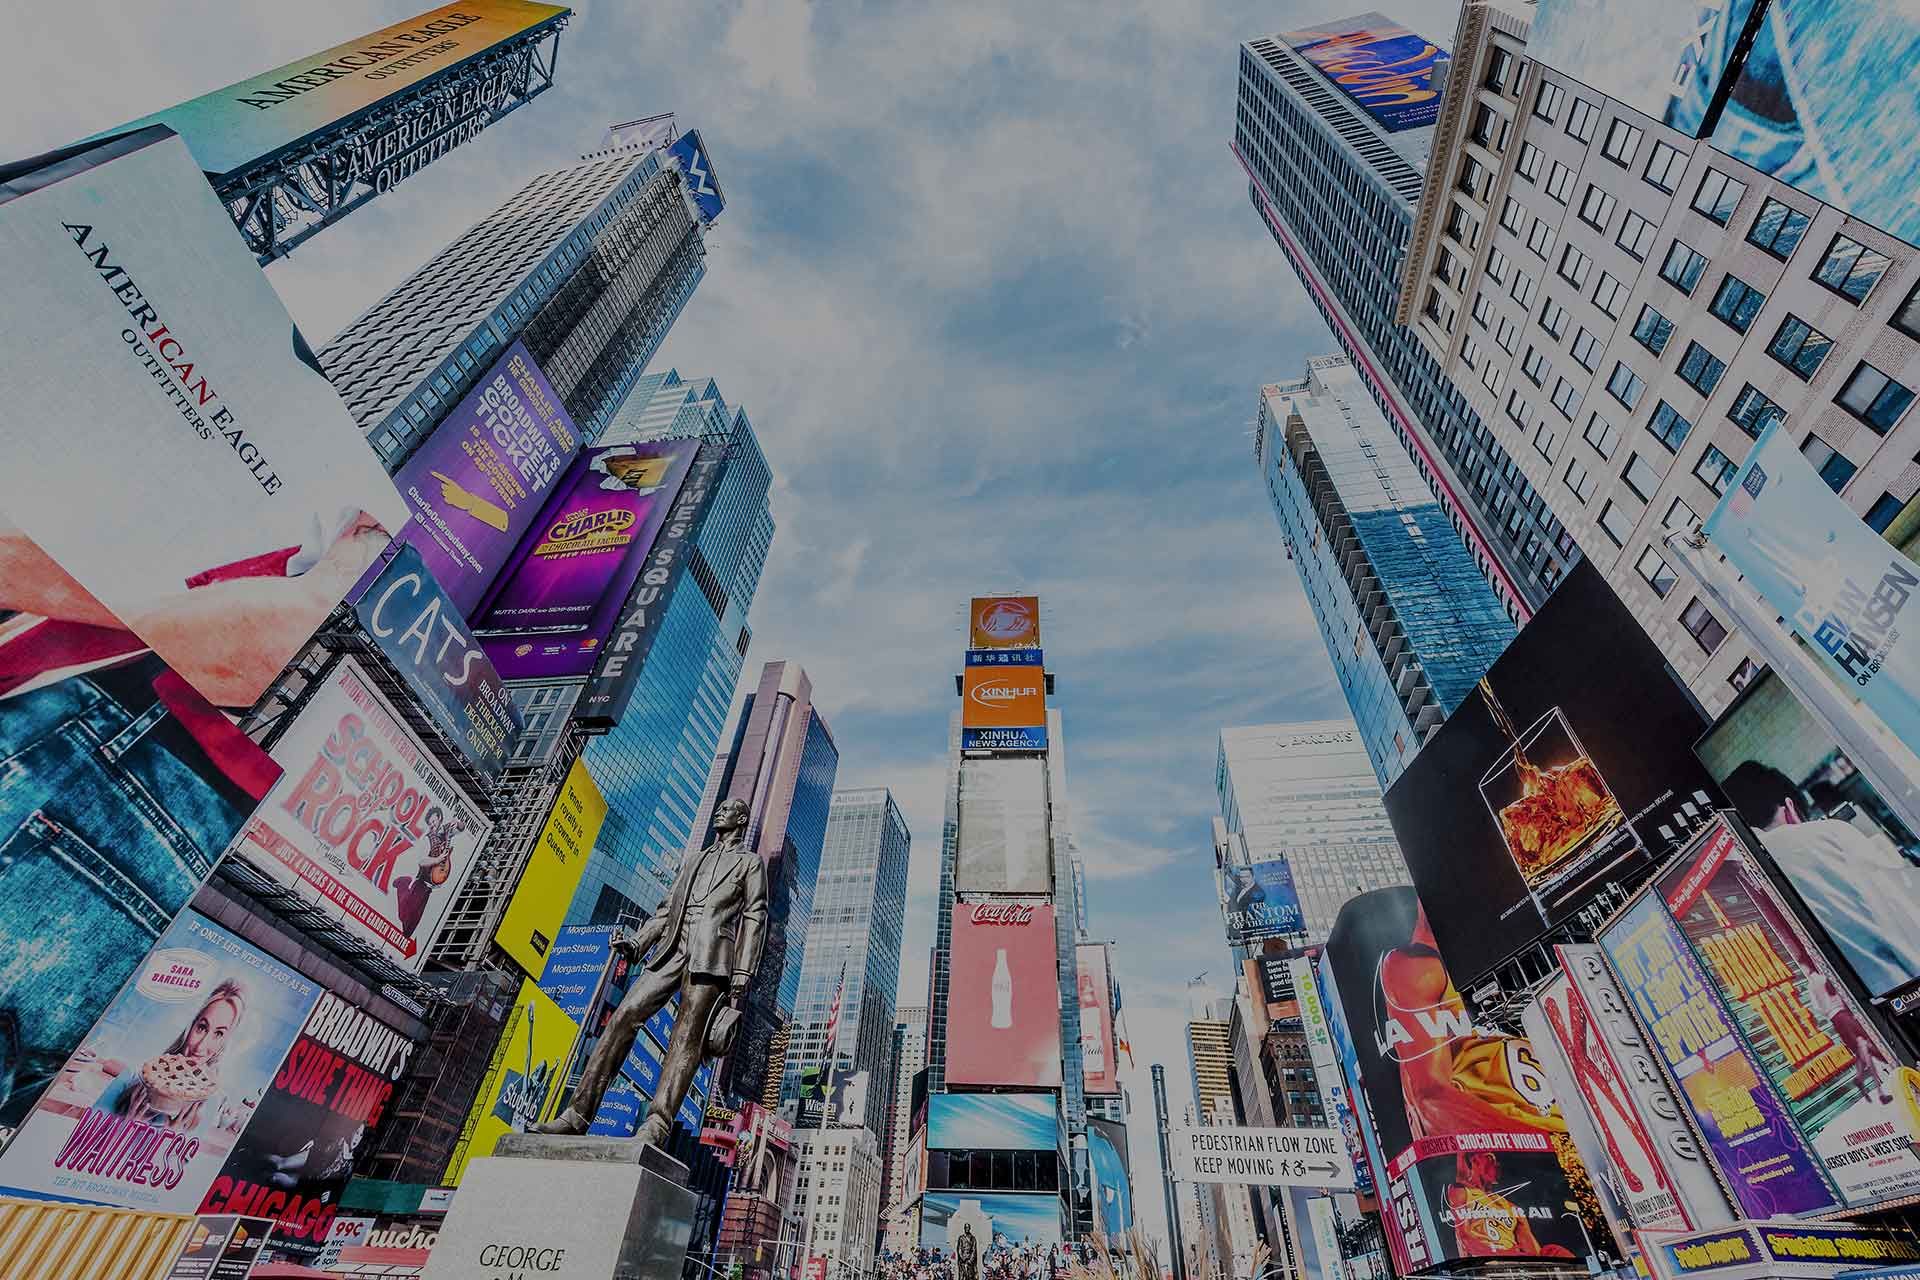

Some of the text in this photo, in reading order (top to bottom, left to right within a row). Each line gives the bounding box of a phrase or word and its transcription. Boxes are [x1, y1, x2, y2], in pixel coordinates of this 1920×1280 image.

[237, 13, 482, 111] AMERICAN EAGLE
[364, 40, 460, 80] OUTFITTERS
[345, 68, 511, 182] AMERICAN EAGLE
[376, 111, 489, 194] OUTFITTERS
[61, 222, 283, 496] AMERICAN EAGLE
[121, 328, 211, 440] OUTFITTERS
[513, 355, 554, 417] CHARLIE
[484, 387, 554, 485] GOLDEN
[492, 374, 561, 473] BROADWAY'S
[475, 395, 546, 493] TICKET
[550, 510, 632, 539] CHARLIE
[371, 573, 483, 686] CATS
[972, 653, 1035, 663] 新华通讯社
[980, 687, 1037, 697] XINHUA
[1856, 668, 1872, 687] ON
[478, 679, 516, 735] BROADWAY
[497, 687, 512, 707] ON
[588, 695, 610, 703] NYC
[464, 703, 498, 749] DECEMBER
[475, 698, 506, 741] THROUGH
[979, 730, 1029, 740] XINHUA
[968, 739, 1040, 748] NEWS AGENCY
[323, 713, 431, 839] SCHOOL
[425, 772, 457, 810] BROADWAY
[567, 785, 584, 814] Tennis
[281, 752, 414, 896] ROCK
[553, 818, 580, 857] crowned in
[559, 802, 584, 838] royalty is
[324, 876, 336, 894] TO
[334, 883, 350, 903] THE
[567, 925, 595, 936] Morgan
[971, 902, 1032, 926] Coca-Cola
[1223, 903, 1300, 925] PHANTOM
[570, 943, 601, 955] Stanley
[1700, 922, 1796, 1001] BRONX
[151, 972, 201, 990] BAREILLES
[169, 964, 194, 977] SARA
[551, 964, 580, 975] Morgan
[556, 983, 587, 996] Stanley
[304, 992, 414, 1080] BROADWAY'S
[1748, 980, 1834, 1070] TALE
[1582, 956, 1697, 1161] PALACE
[275, 1039, 394, 1129] SURE THING
[593, 1115, 617, 1127] Stanley
[54, 1105, 201, 1190] WAITRESS
[1192, 1135, 1338, 1154] PEDESTRIAN FLOW ZONE
[1456, 1132, 1512, 1150] CHOCOLATE
[1512, 1132, 1548, 1150] WORLD
[1824, 1152, 1850, 1170] JERSEY
[1847, 1146, 1870, 1164] BOYS
[1866, 1146, 1875, 1158] &
[1871, 1140, 1896, 1157] WEST
[1891, 1134, 1911, 1151] SIDE
[1193, 1156, 1275, 1176] KEEP MOVING
[197, 1175, 337, 1244] CHICAGO
[331, 1239, 345, 1247] NYC
[480, 1244, 565, 1271] GEORGE
